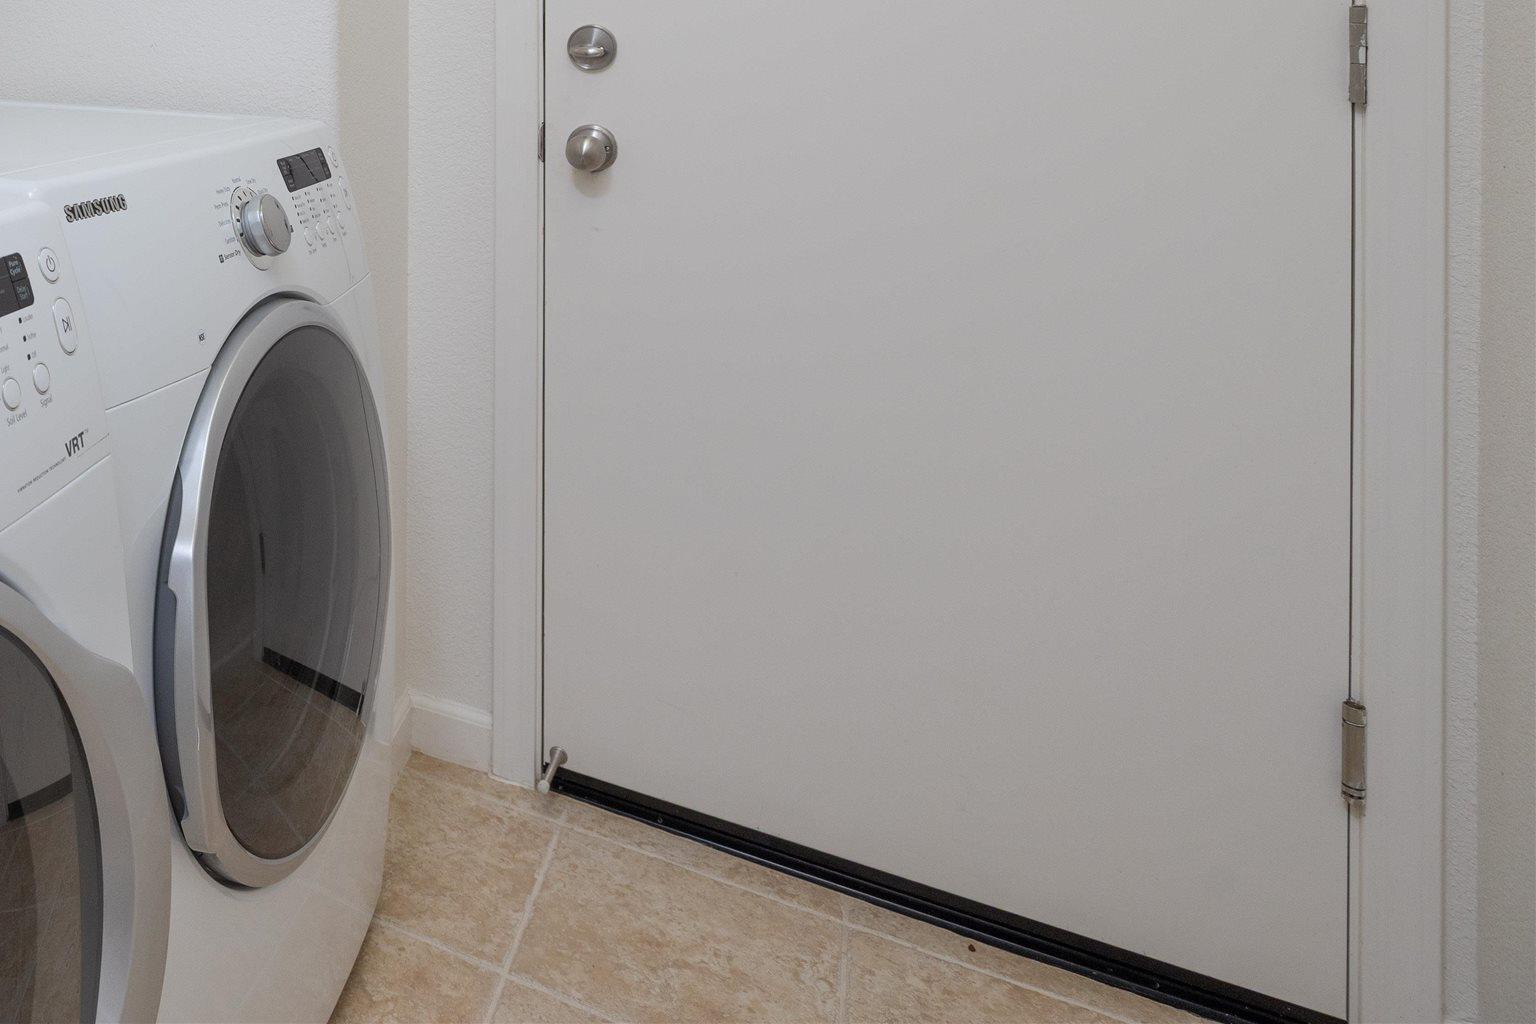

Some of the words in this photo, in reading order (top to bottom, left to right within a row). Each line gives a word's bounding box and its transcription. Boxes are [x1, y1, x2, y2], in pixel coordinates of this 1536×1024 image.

[64, 194, 128, 223] SAMSUNG
[6, 415, 16, 427] Soil
[15, 409, 28, 423] Level
